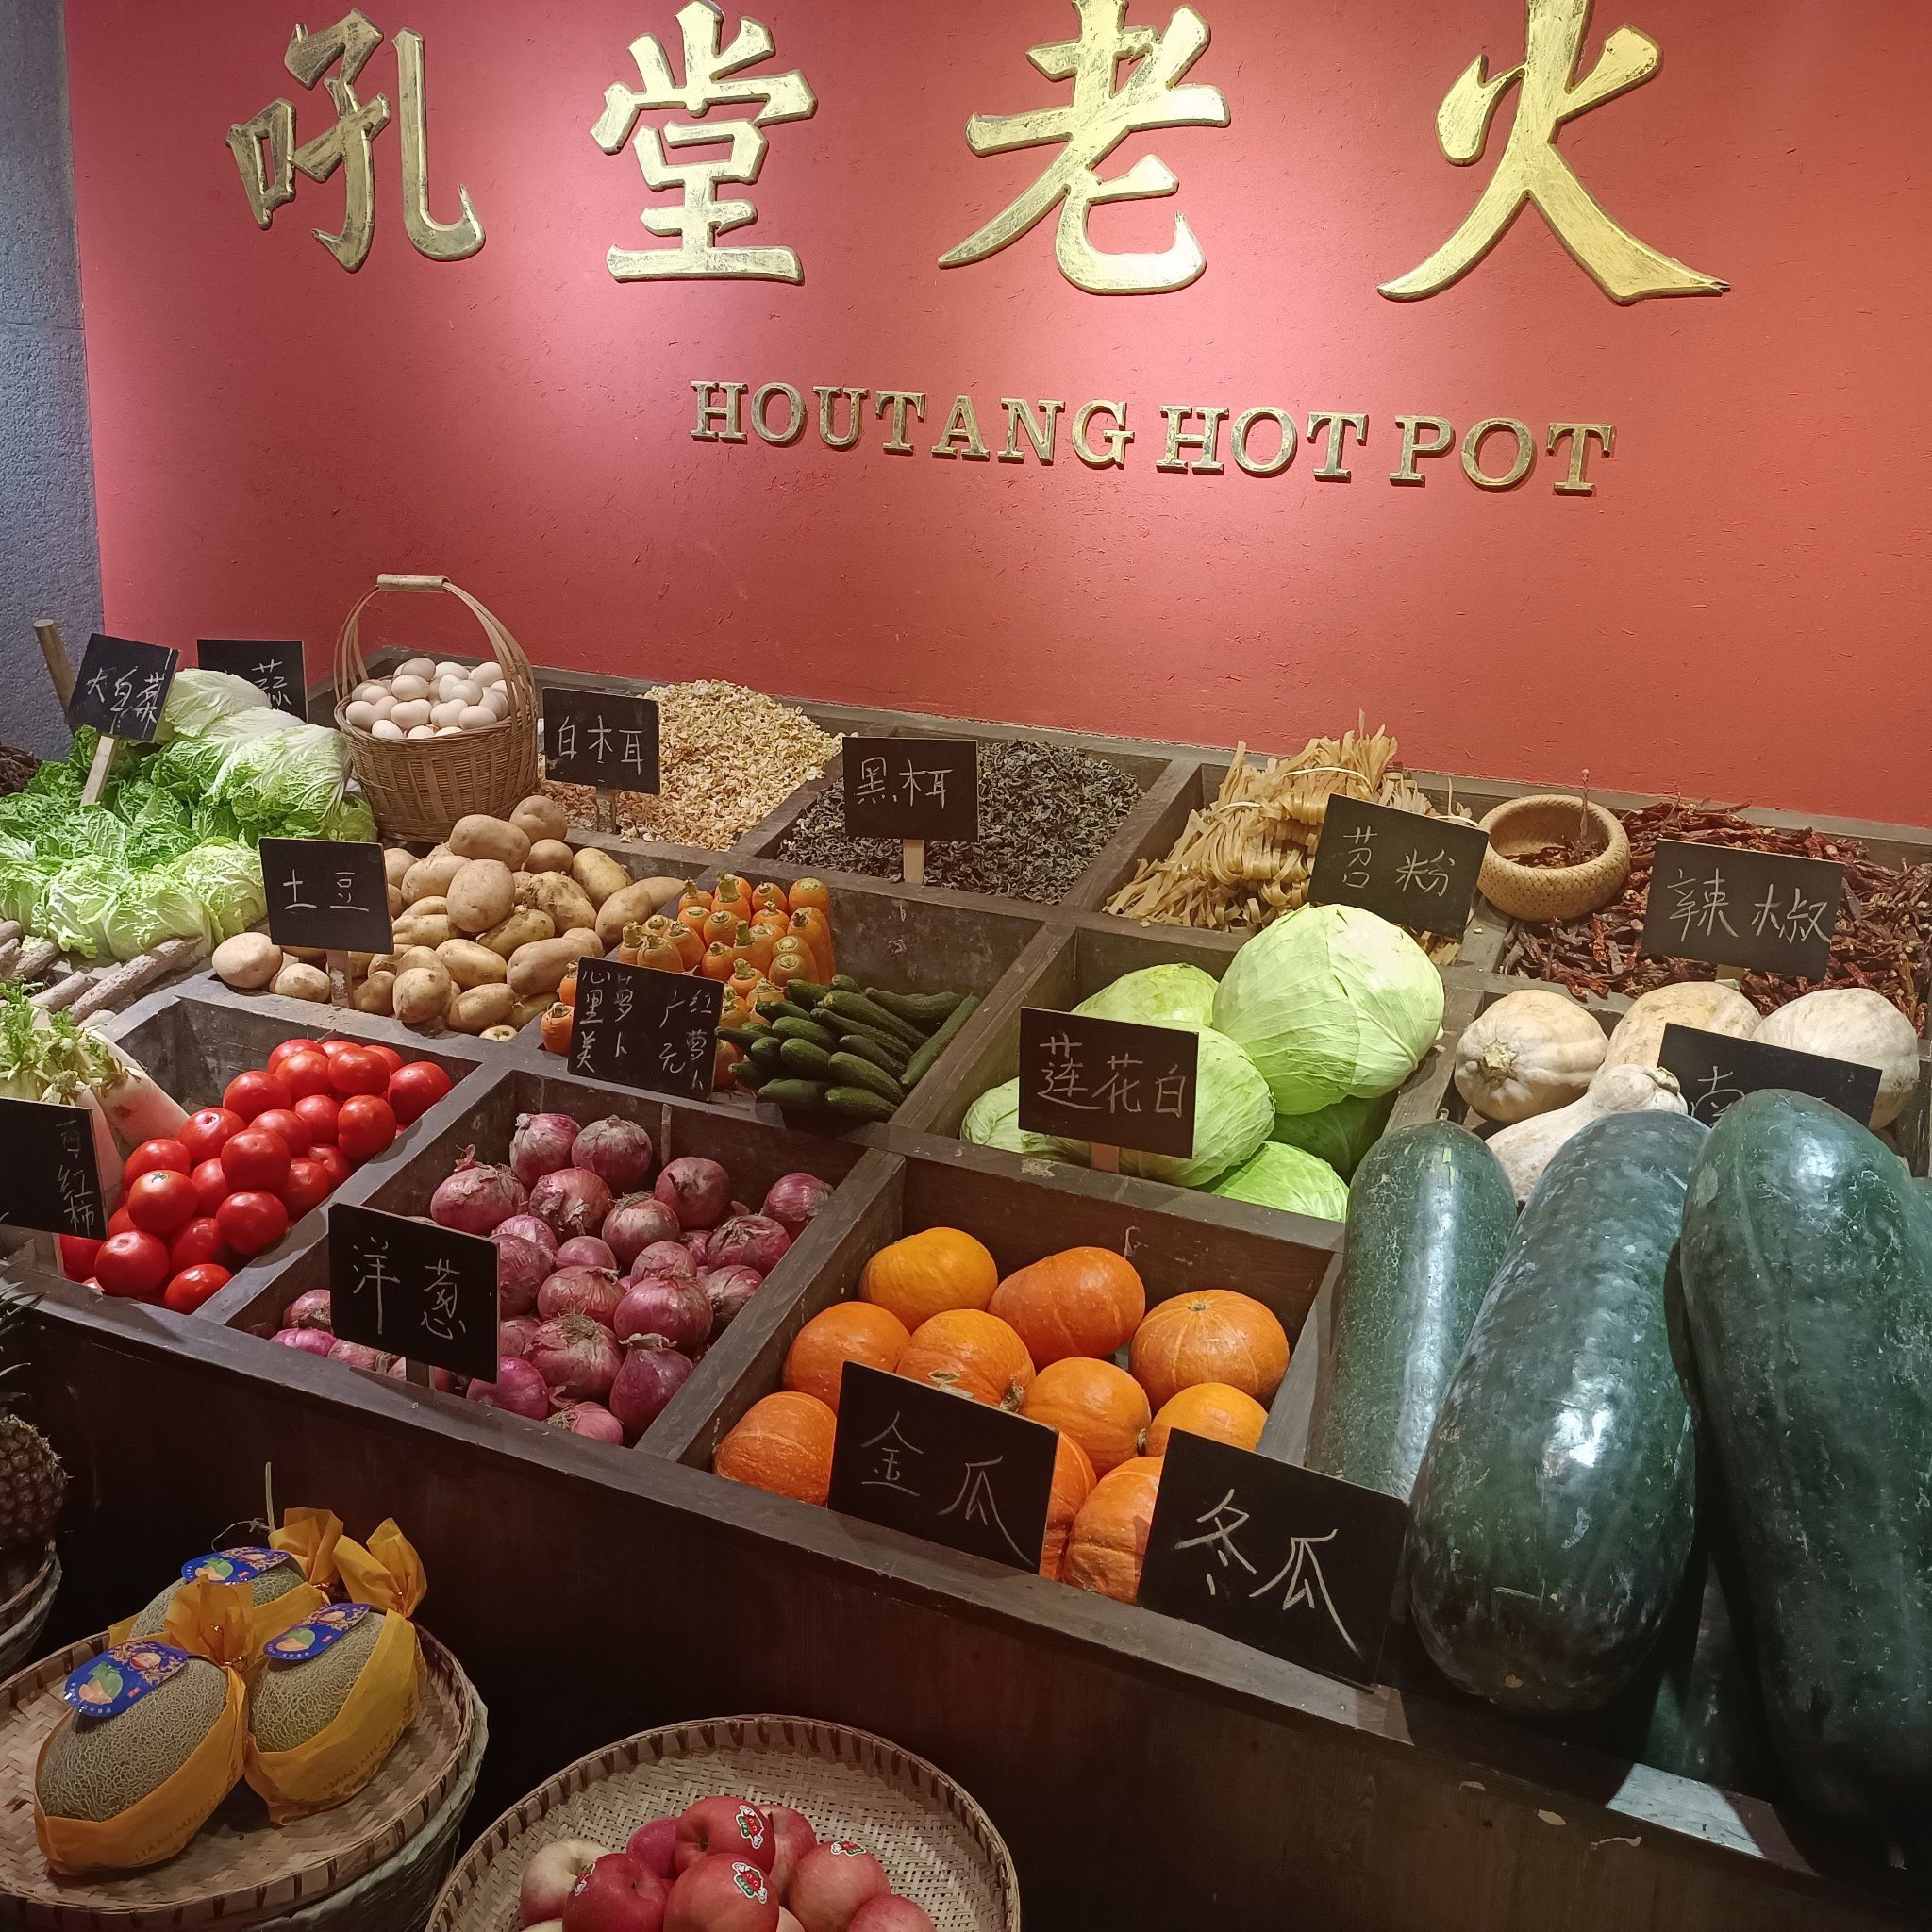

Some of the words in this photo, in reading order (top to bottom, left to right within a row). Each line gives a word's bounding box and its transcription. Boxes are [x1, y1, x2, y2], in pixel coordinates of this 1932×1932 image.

[226, 0, 1732, 304] 吼堂老火
[690, 379, 1136, 470] HOUTANG
[1155, 405, 1371, 482] HOT
[1389, 414, 1617, 496] POT
[558, 714, 644, 776] 白木耳
[853, 756, 954, 810] 黑木耳
[282, 868, 370, 912] 土豆
[1341, 825, 1456, 897] 苕粉
[1666, 867, 1833, 945] 辣椒
[1037, 1032, 1188, 1119] 莲花白
[352, 1235, 467, 1341] 洋葱
[860, 1409, 1037, 1570] 金瓜
[1174, 1487, 1363, 1660] 冬瓜
